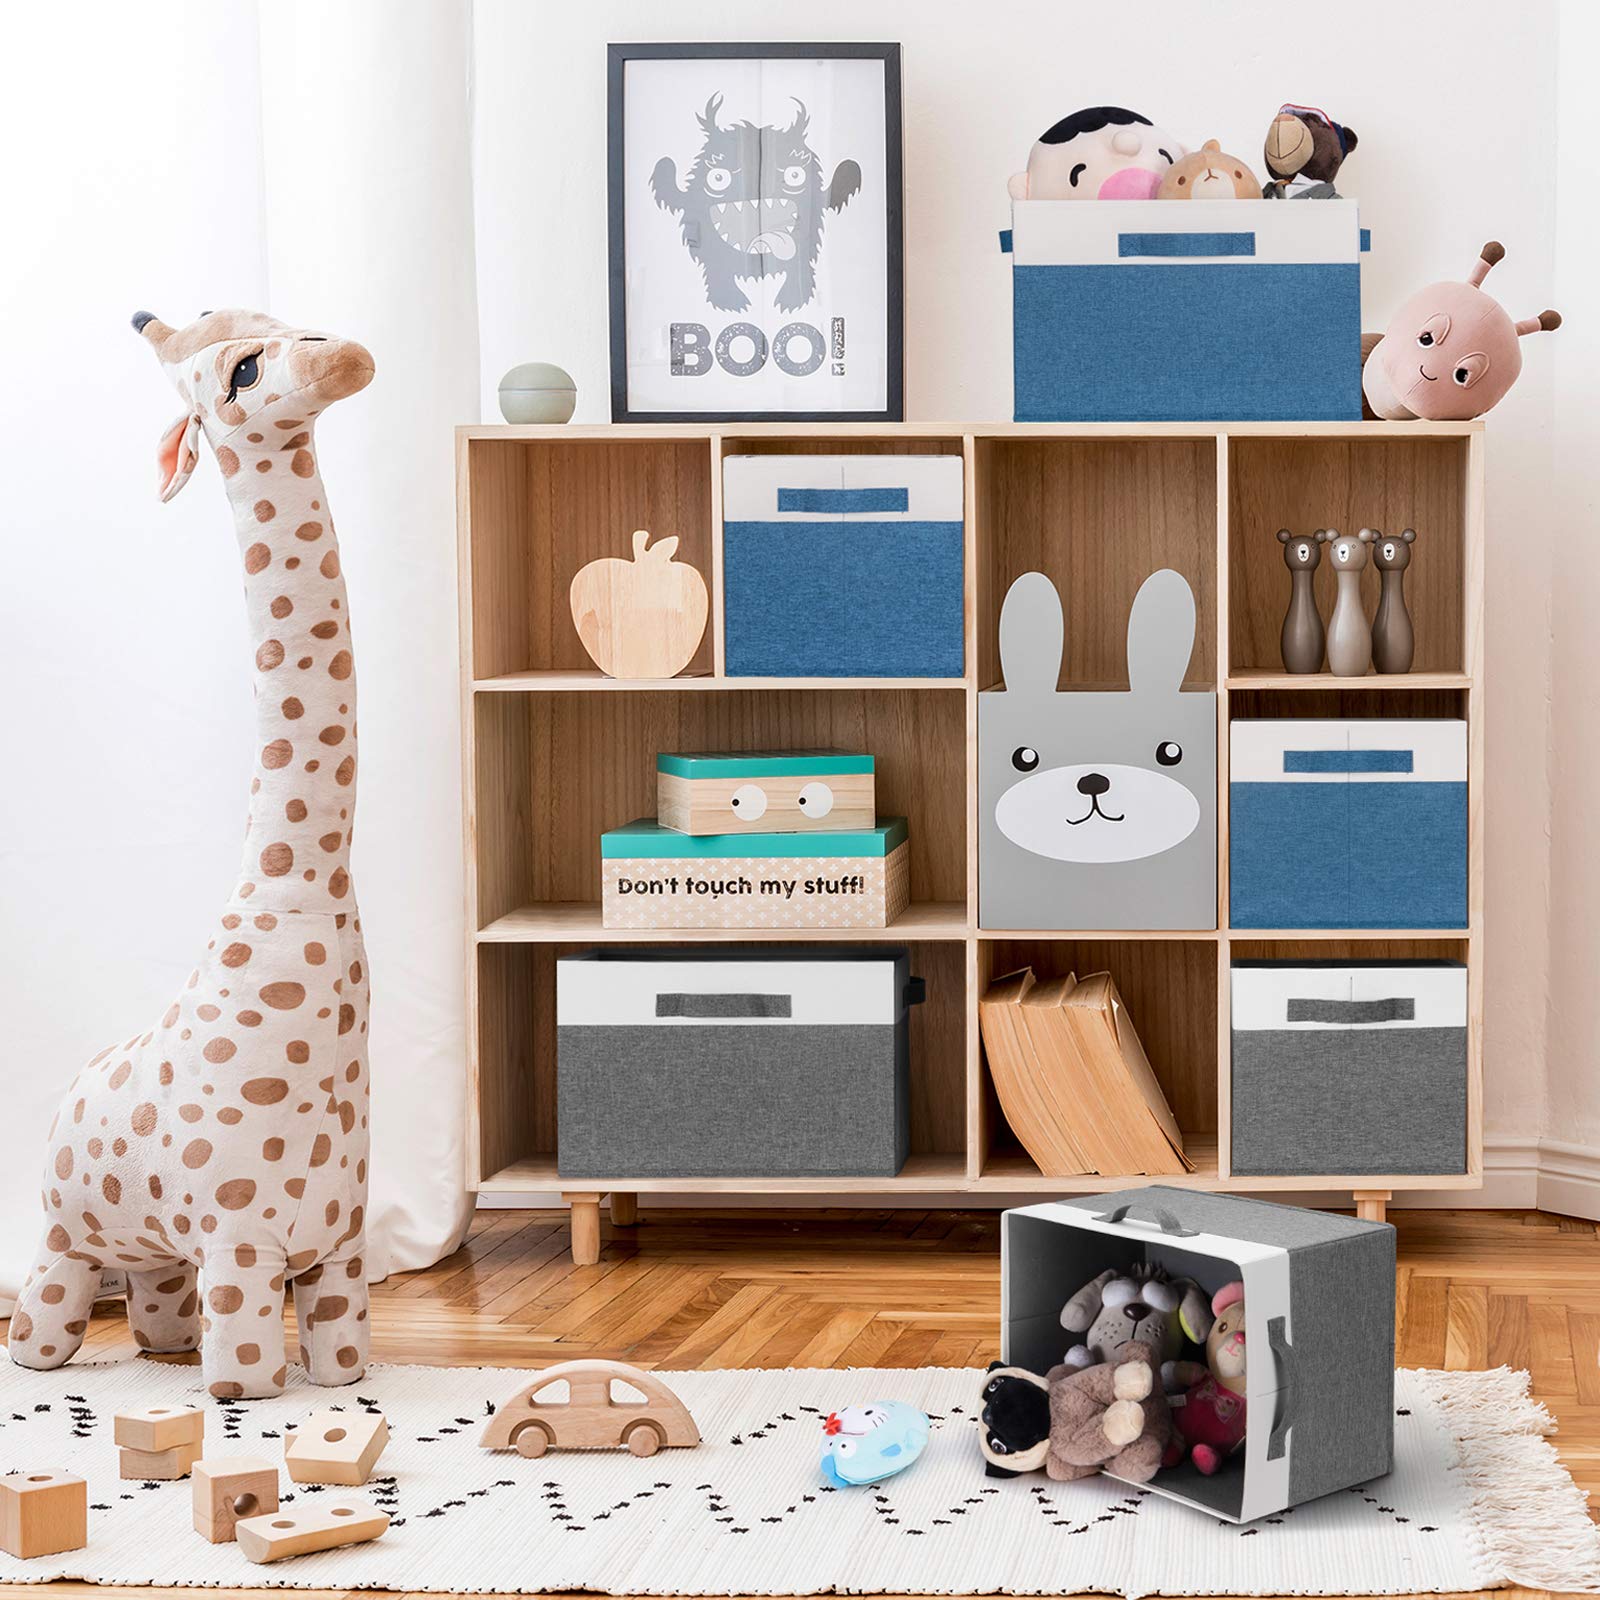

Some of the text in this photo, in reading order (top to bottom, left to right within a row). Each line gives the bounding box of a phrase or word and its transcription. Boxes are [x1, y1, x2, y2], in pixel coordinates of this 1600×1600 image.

[670, 317, 845, 377] BOO!
[618, 875, 865, 899] Don't touch my stuff!
